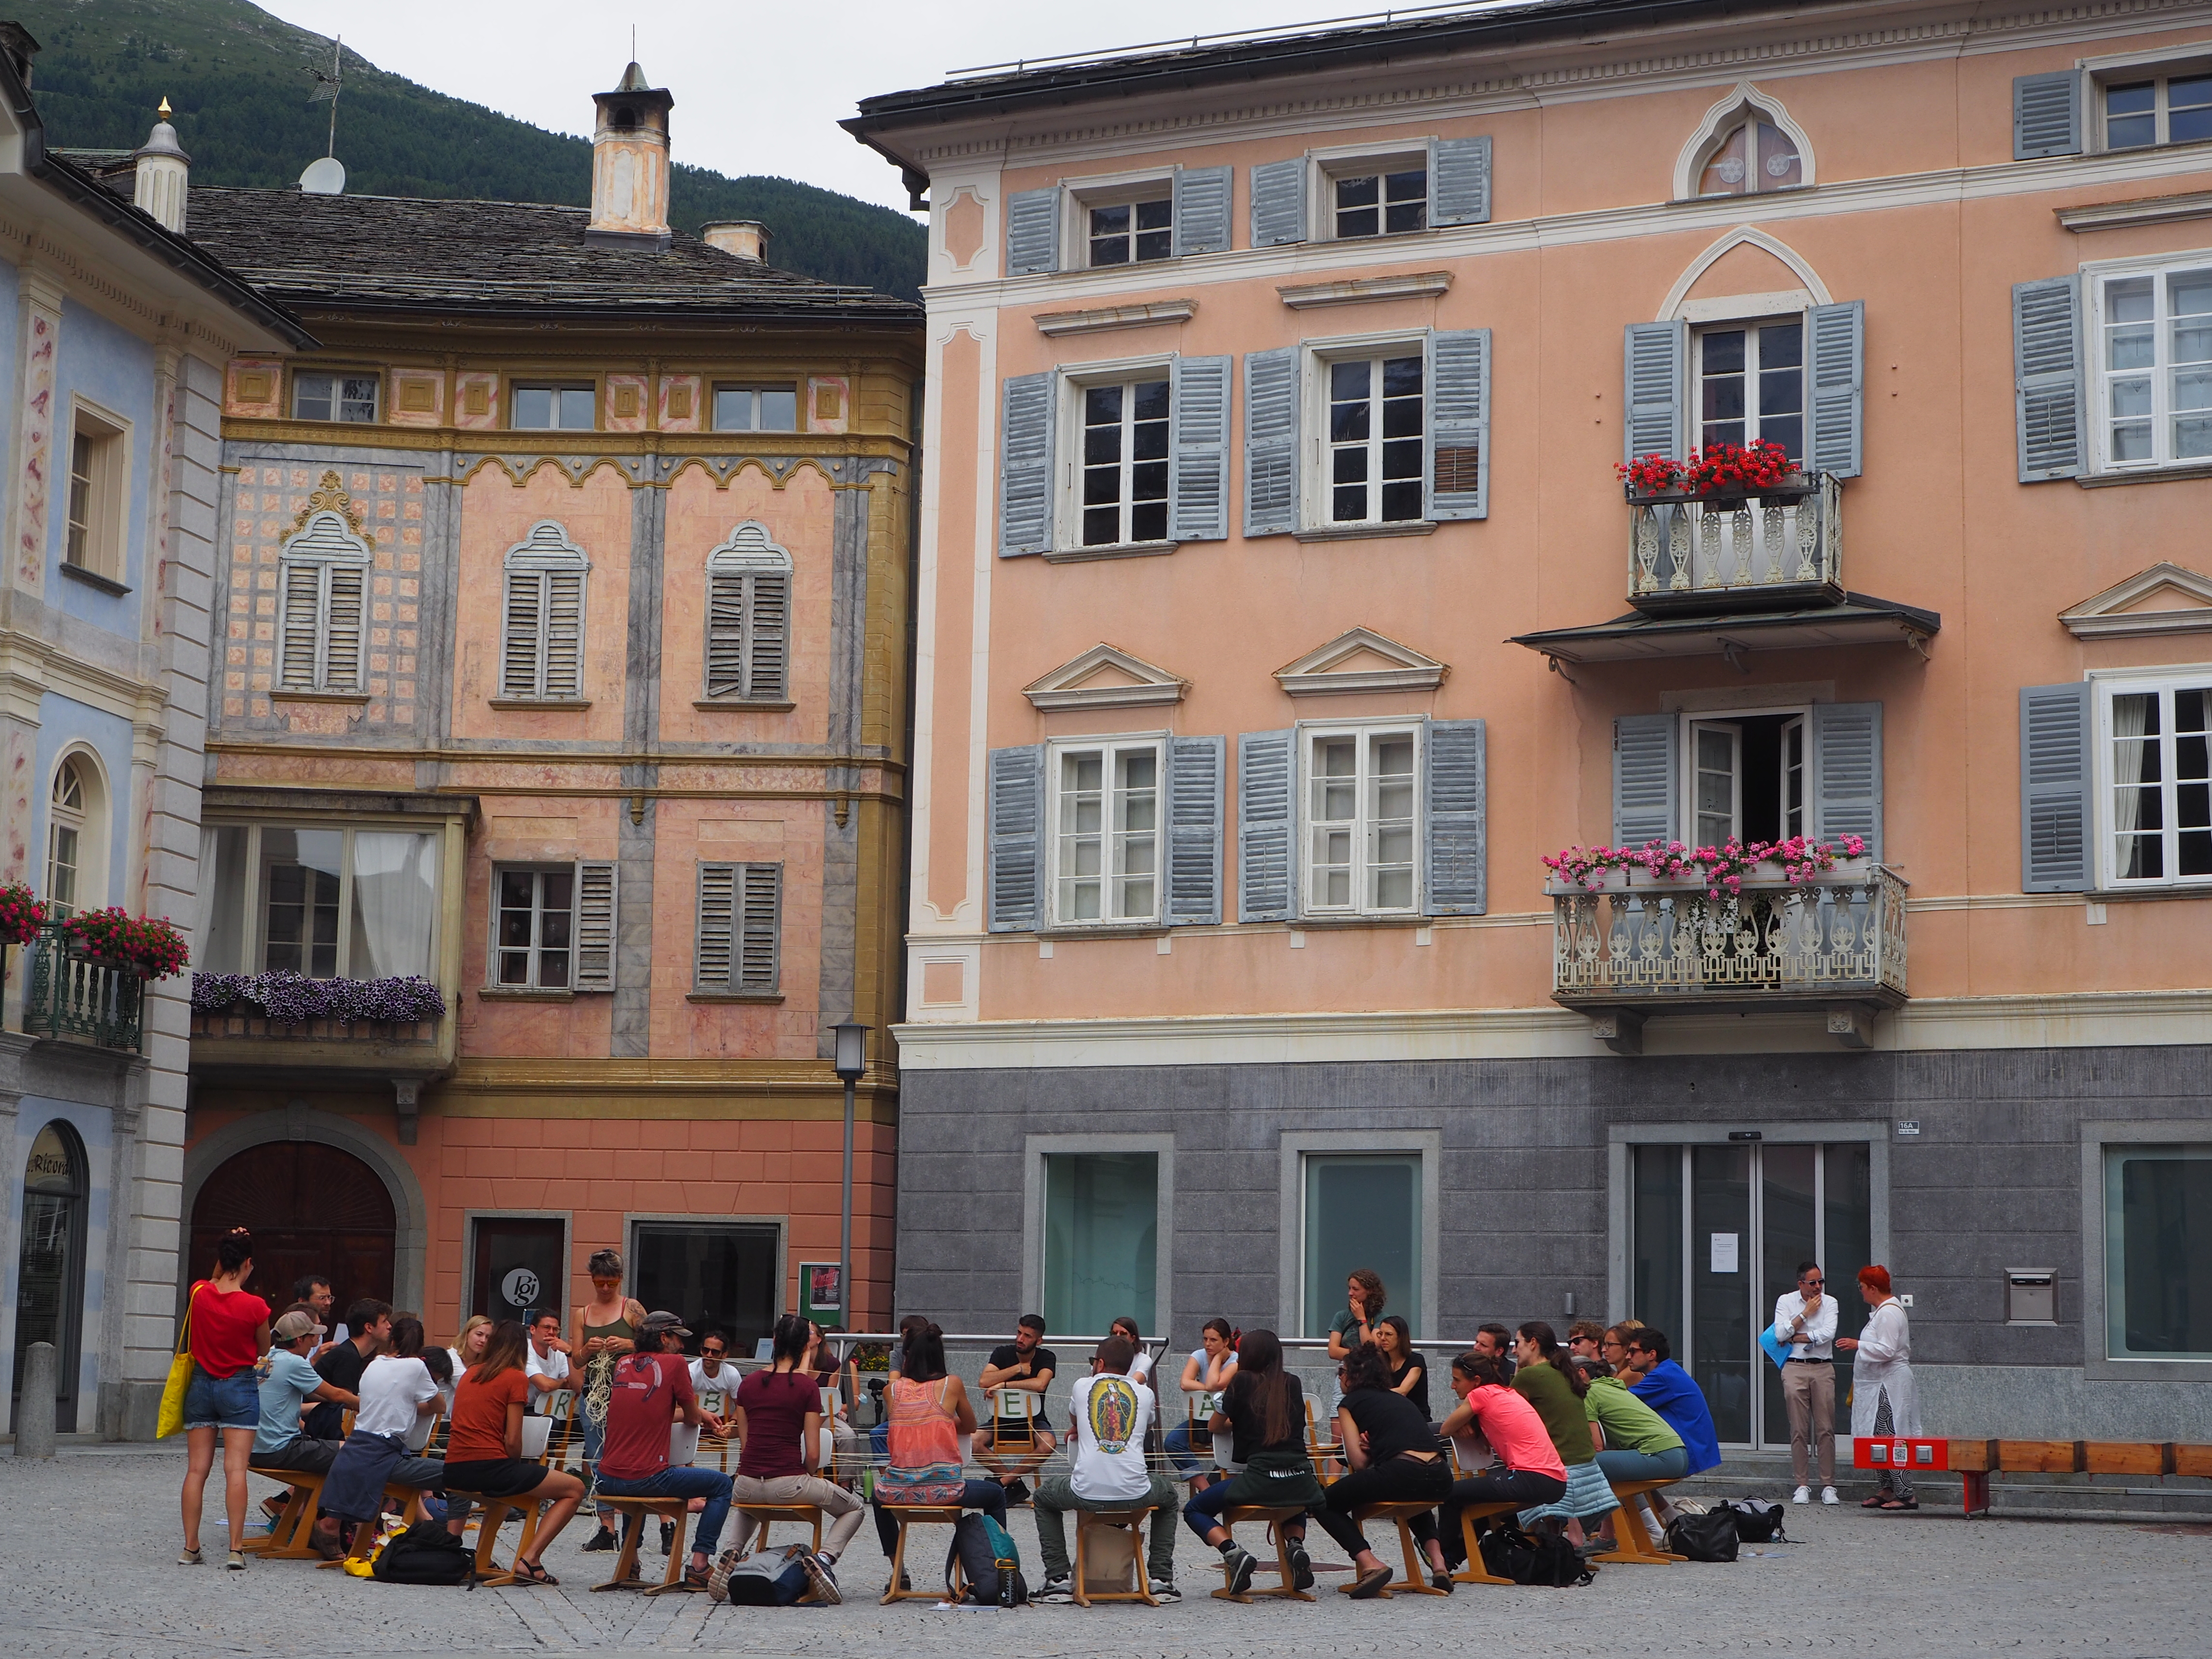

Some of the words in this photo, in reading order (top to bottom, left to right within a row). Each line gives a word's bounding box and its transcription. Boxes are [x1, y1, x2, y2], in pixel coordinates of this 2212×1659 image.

[554, 1392, 570, 1416] R
[703, 1391, 721, 1413] B
[1004, 1393, 1021, 1415] E
[1199, 1394, 1216, 1417] A
